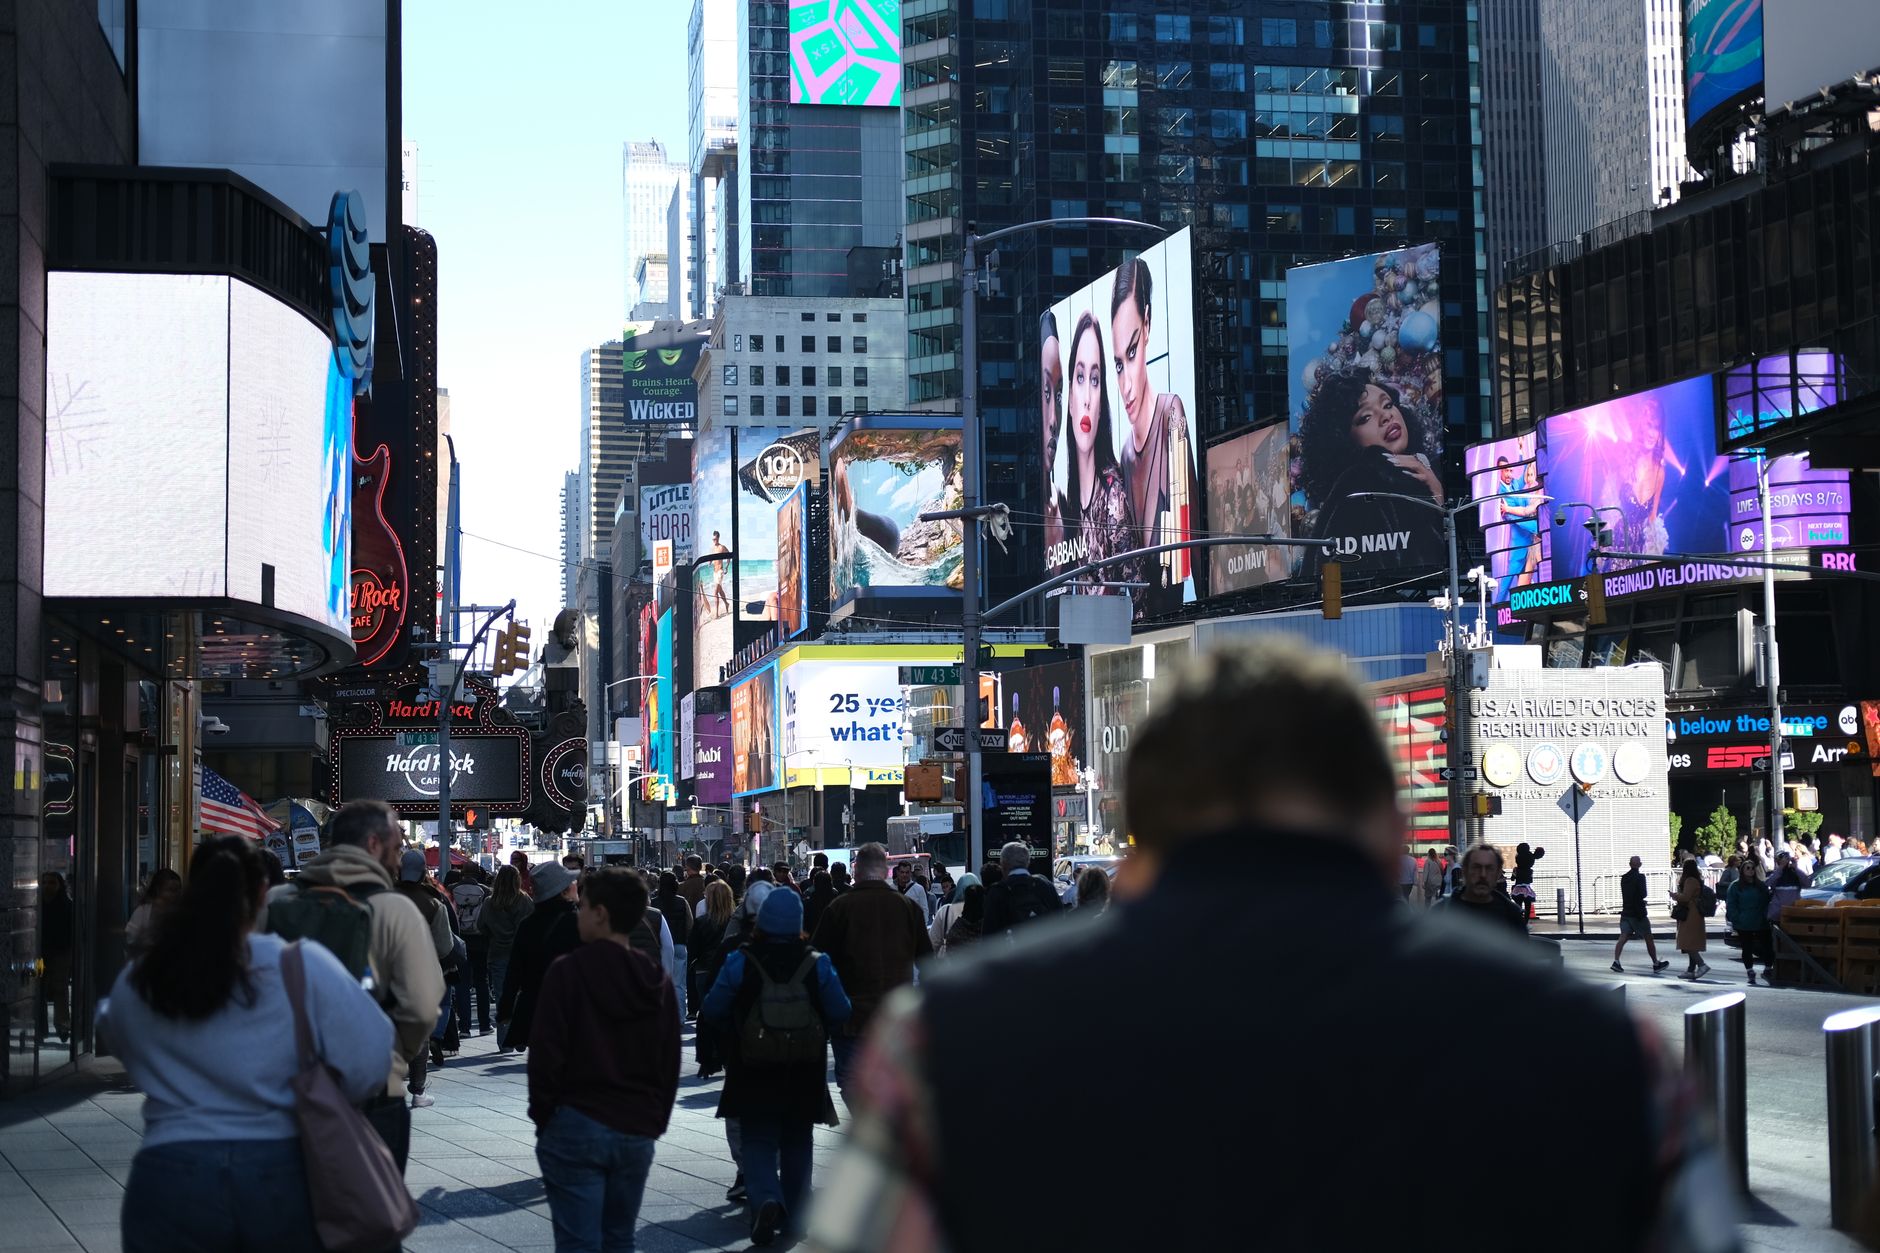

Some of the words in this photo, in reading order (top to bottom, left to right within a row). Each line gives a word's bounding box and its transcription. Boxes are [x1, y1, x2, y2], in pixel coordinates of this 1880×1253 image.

[632, 378, 664, 387] Brains.
[665, 377, 694, 386] Heart.
[643, 387, 682, 397] Courage.
[763, 455, 794, 475] 101
[649, 486, 690, 511] LITTLE
[1737, 498, 1753, 514] LIVE
[1754, 493, 1813, 511] TESDAYS
[1362, 531, 1411, 553] NAVY
[1808, 529, 1843, 541] hulu
[1047, 535, 1088, 570] GABBANA
[1227, 555, 1244, 575] OLD
[1244, 549, 1268, 571] NAVY
[1605, 570, 1655, 598] REGINALD
[361, 580, 401, 613] Rock
[1511, 584, 1573, 612] EDOROSCIK
[351, 615, 371, 627] CAFE
[913, 669, 925, 683] W
[930, 668, 945, 683] 43
[950, 668, 960, 678] St
[336, 688, 376, 698] SPECTACOLOR
[829, 693, 860, 713] 25
[388, 700, 431, 718] Hard
[1470, 697, 1500, 718] U.S.
[1503, 697, 1580, 718] ARMED
[1581, 697, 1657, 718] FORCES
[830, 720, 903, 742] what's
[1478, 721, 1577, 738] RECRUITING
[1581, 721, 1649, 738] STATION
[1680, 716, 1732, 735] below
[1736, 714, 1771, 733] the
[406, 735, 414, 743] W
[943, 734, 965, 745] ONE
[981, 734, 1002, 746] WAY
[1103, 724, 1129, 754] OLD
[386, 753, 431, 772] Hard
[1666, 752, 1692, 771] yes
[1707, 745, 1772, 769] ESP
[868, 770, 903, 781] Let's
